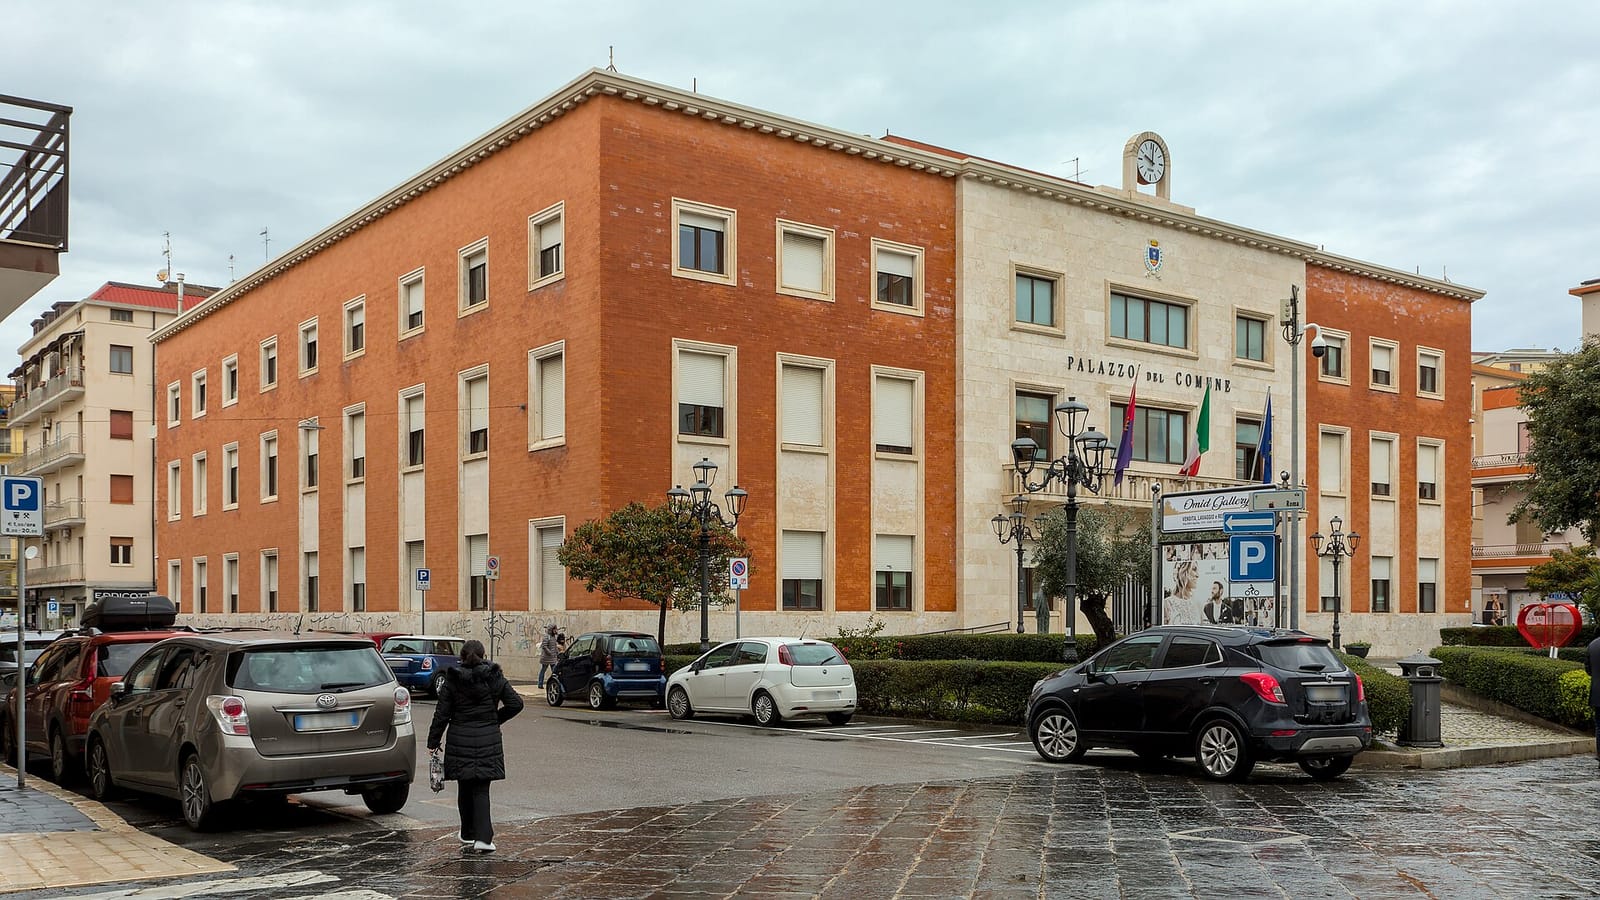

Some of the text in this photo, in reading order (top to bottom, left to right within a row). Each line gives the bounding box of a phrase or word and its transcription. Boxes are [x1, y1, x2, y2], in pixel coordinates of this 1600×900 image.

[1068, 356, 1231, 393] PALAZZO DEL COMUNE
[11, 484, 31, 507] P
[1183, 496, 1250, 511] Omid Gallery
[1239, 540, 1266, 576] P
[419, 571, 427, 580] P
